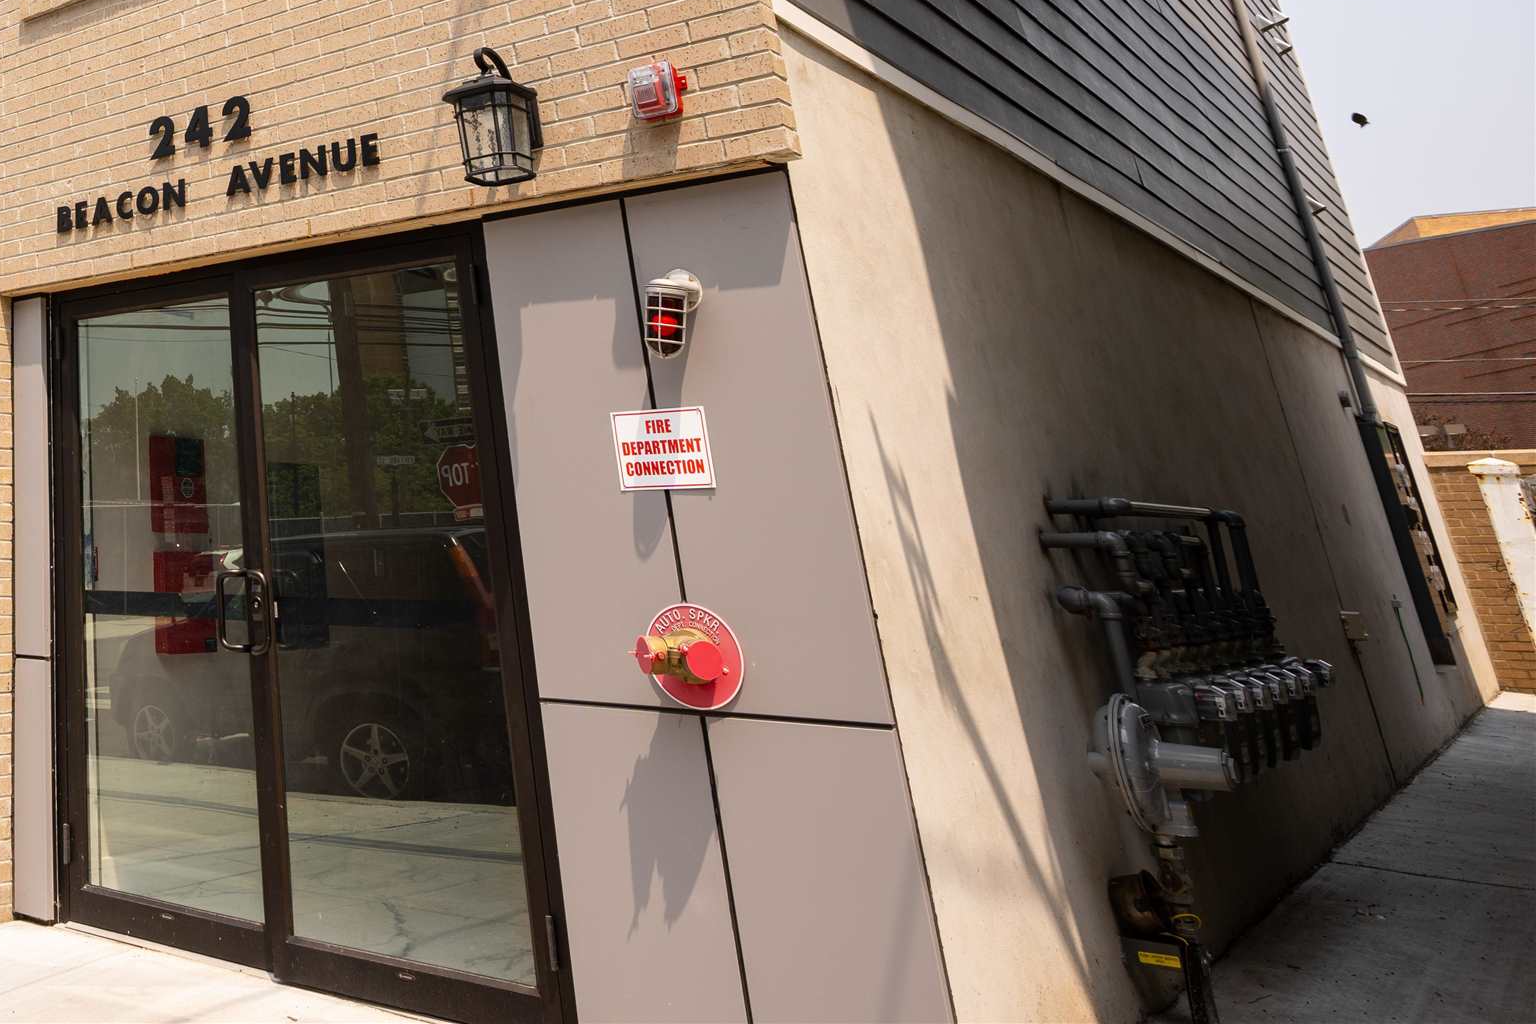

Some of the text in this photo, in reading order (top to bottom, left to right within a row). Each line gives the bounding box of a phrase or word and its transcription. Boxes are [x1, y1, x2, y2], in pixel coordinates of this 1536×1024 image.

[149, 95, 252, 160] 242
[56, 132, 381, 234] BEACON AVENUE
[645, 418, 672, 434] FIRE
[622, 438, 701, 456] DEPARTMENT
[626, 459, 705, 477] CONNECTION
[655, 608, 720, 634] AUTO. SPKR.
